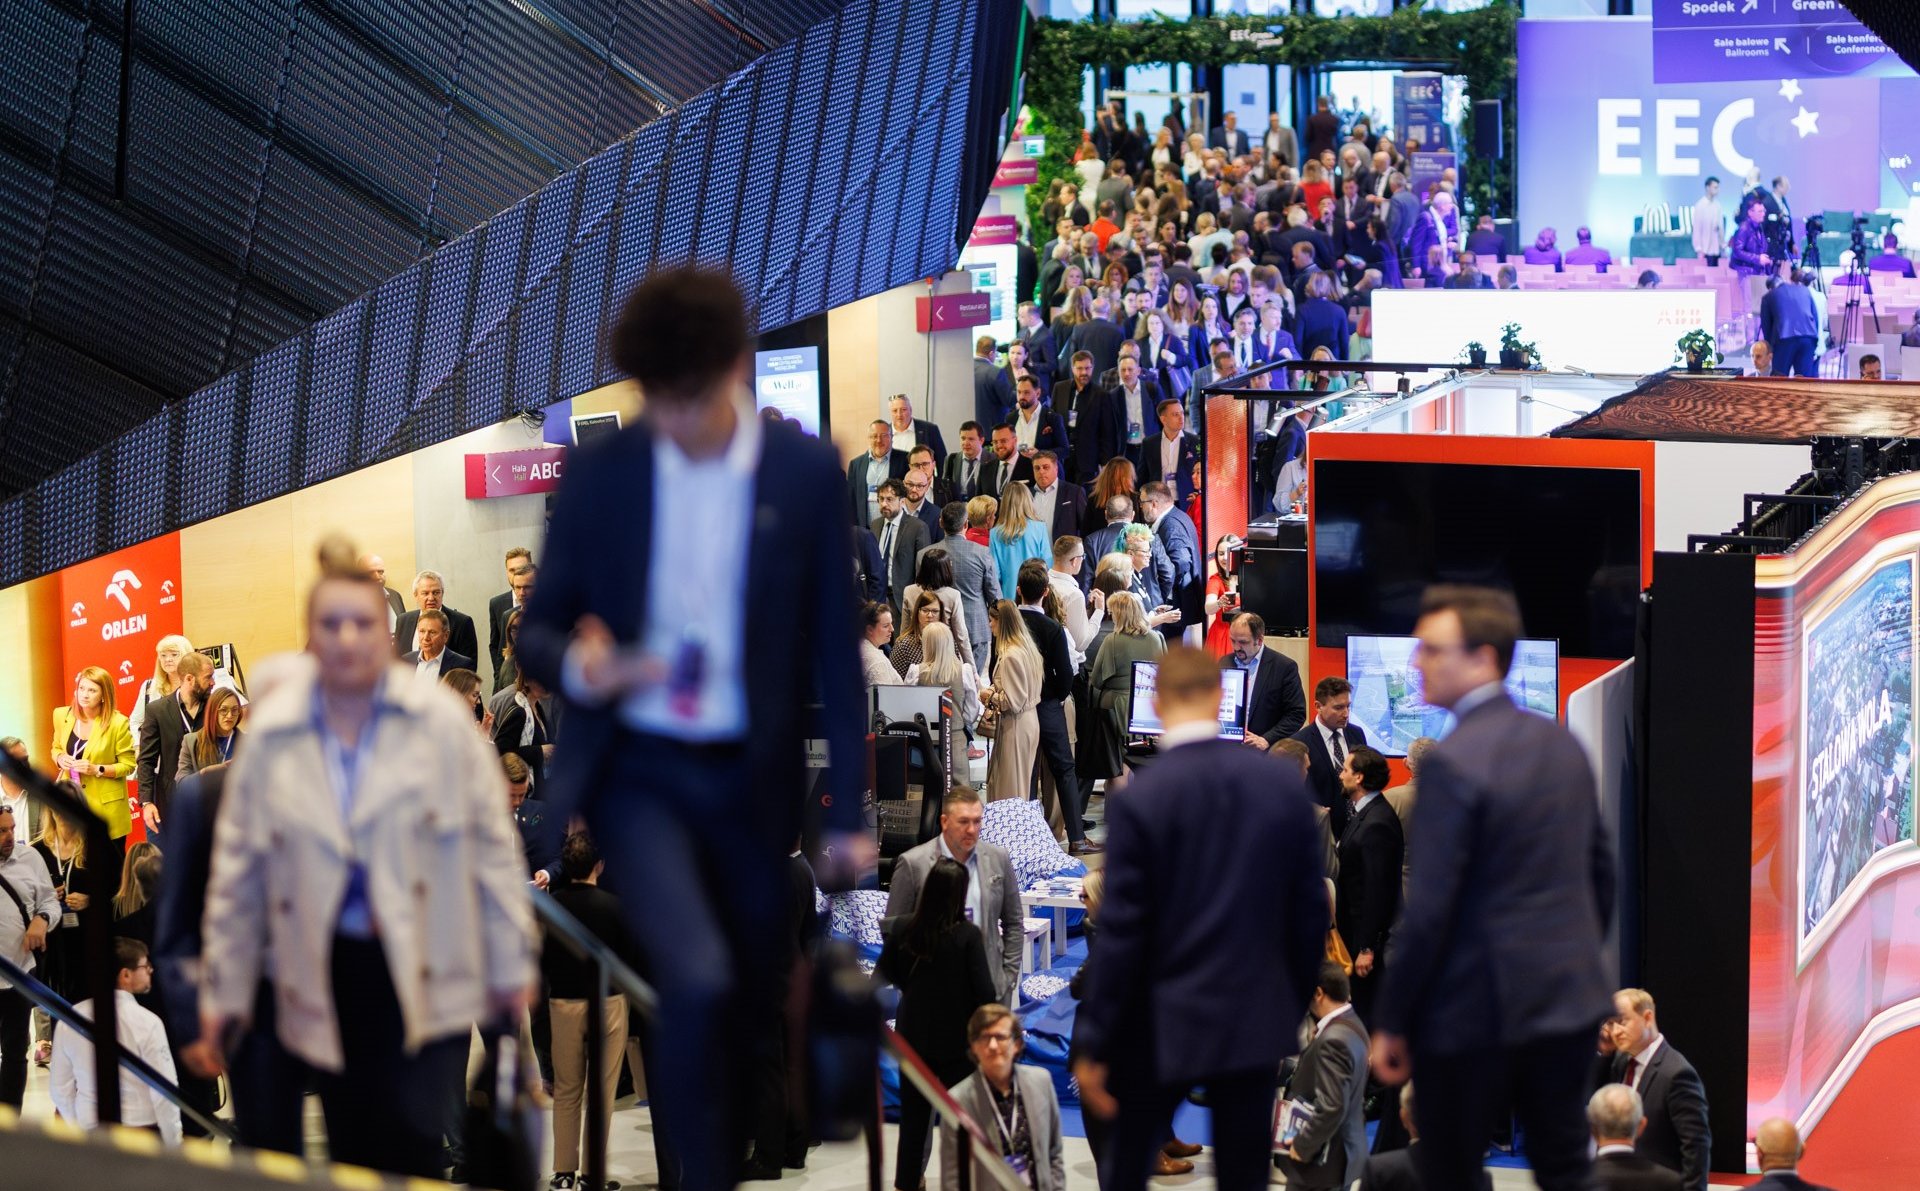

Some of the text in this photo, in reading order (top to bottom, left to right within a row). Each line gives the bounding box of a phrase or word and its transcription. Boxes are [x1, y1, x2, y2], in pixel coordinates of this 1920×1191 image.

[1682, 0, 1736, 16] Spodek
[1792, 0, 1835, 10] Green
[1713, 37, 1770, 47] Sale balowe
[1826, 35, 1847, 44] Sale
[1725, 48, 1769, 57] Ballrooms
[1834, 44, 1886, 54] Conference
[1410, 85, 1436, 98] EEC
[1598, 97, 1755, 178] EEC
[511, 461, 562, 481] Hala ABC
[514, 473, 527, 481] Hall
[160, 594, 176, 605] ORLEN
[102, 613, 147, 641] ORLEN
[118, 675, 135, 685] ORLEN
[1812, 689, 1892, 800] STALOWA WOLA
